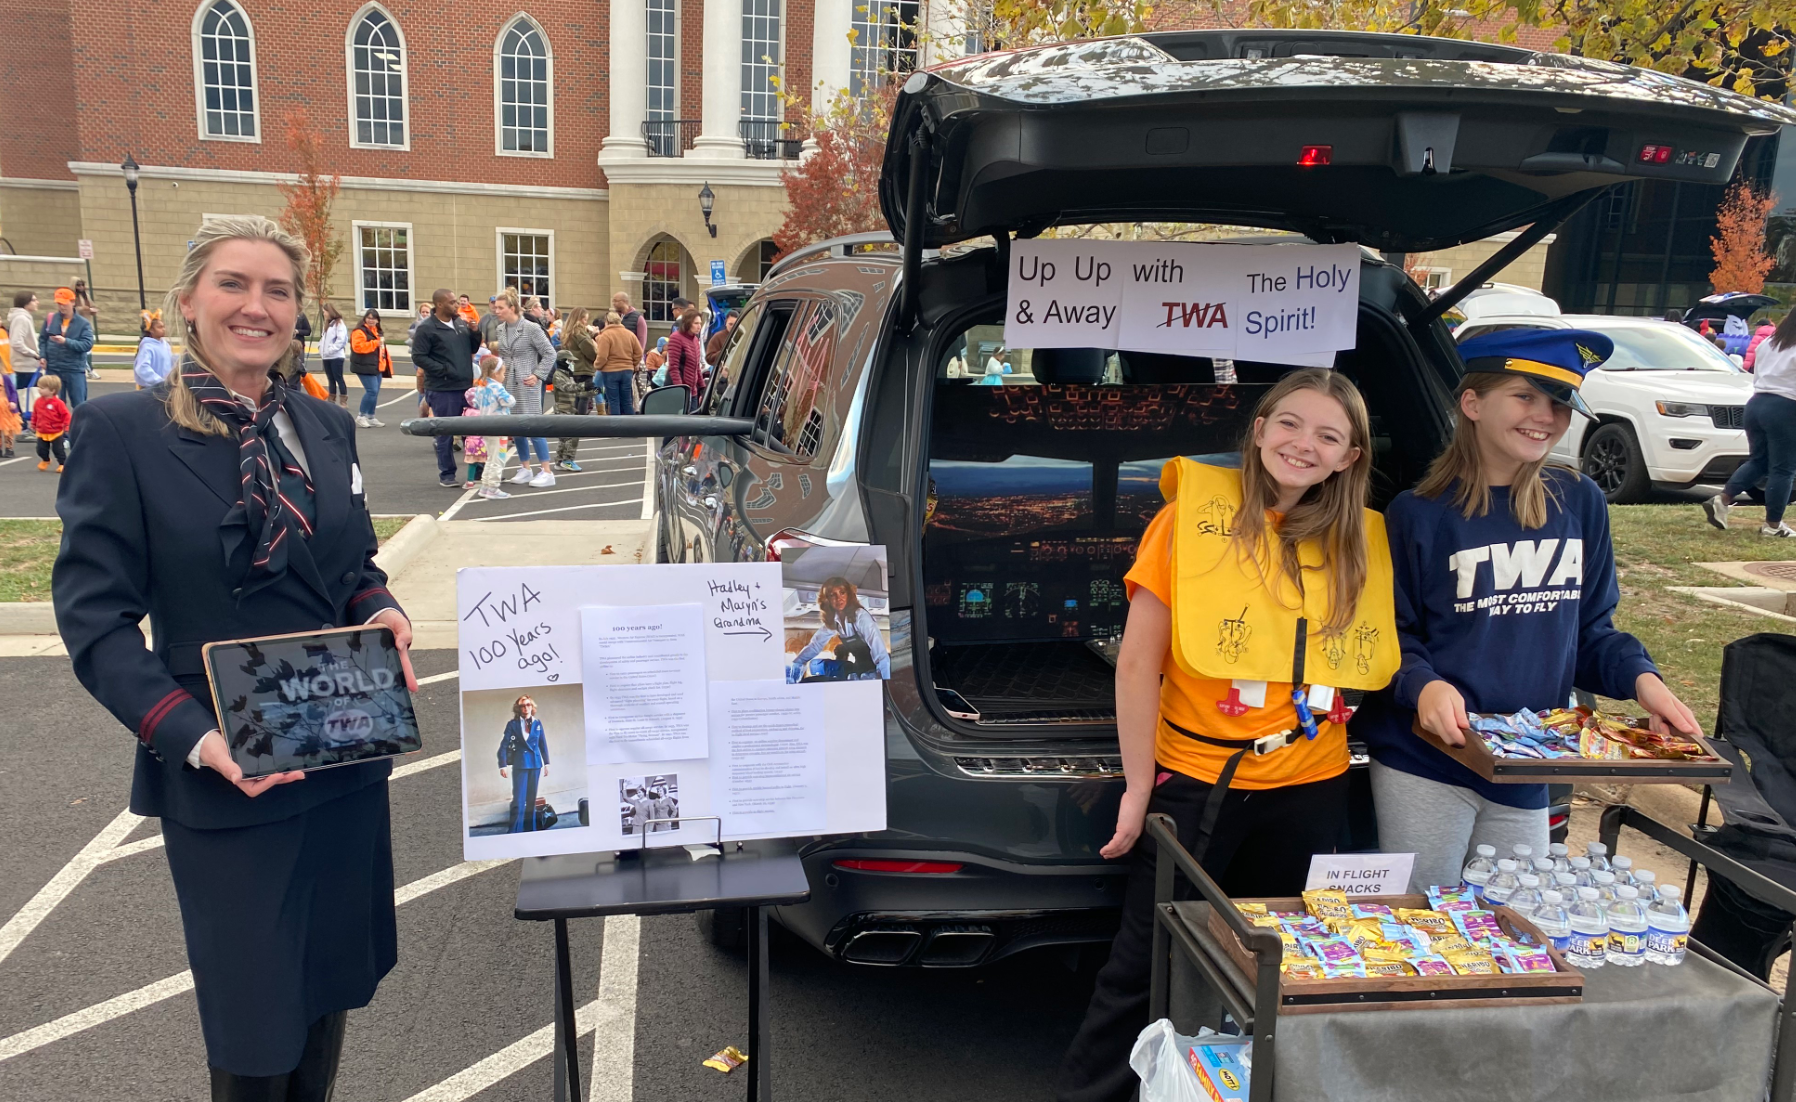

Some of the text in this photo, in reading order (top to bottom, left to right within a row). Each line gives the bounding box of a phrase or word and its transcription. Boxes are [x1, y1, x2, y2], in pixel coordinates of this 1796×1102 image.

[1018, 255, 1112, 288] Up Up
[1132, 258, 1184, 283] with
[1246, 263, 1352, 294] The Holy
[1015, 298, 1117, 330] & Away
[1161, 302, 1229, 329] TWA
[1245, 306, 1317, 339] Spirit!
[1448, 538, 1584, 599] TWA
[706, 579, 751, 600] Hadley
[462, 582, 541, 628] TWA
[720, 597, 768, 617] Maryn's
[1453, 589, 1581, 613] THE MOST COMFORTABL
[1515, 603, 1532, 614] TO
[1534, 601, 1558, 613] FLY
[626, 624, 647, 633] years
[647, 623, 663, 632] ago!
[713, 616, 762, 629] Grandma
[318, 660, 349, 671] THE
[468, 639, 507, 671] 100
[517, 642, 563, 673] ago!
[279, 668, 394, 701] WORLD
[334, 696, 351, 707] OF
[326, 715, 372, 734] TWA
[1326, 869, 1390, 880] IN FLIGHT
[1569, 944, 1592, 955] ARK
[1570, 935, 1591, 948] EER
[1648, 940, 1676, 953] PARK
